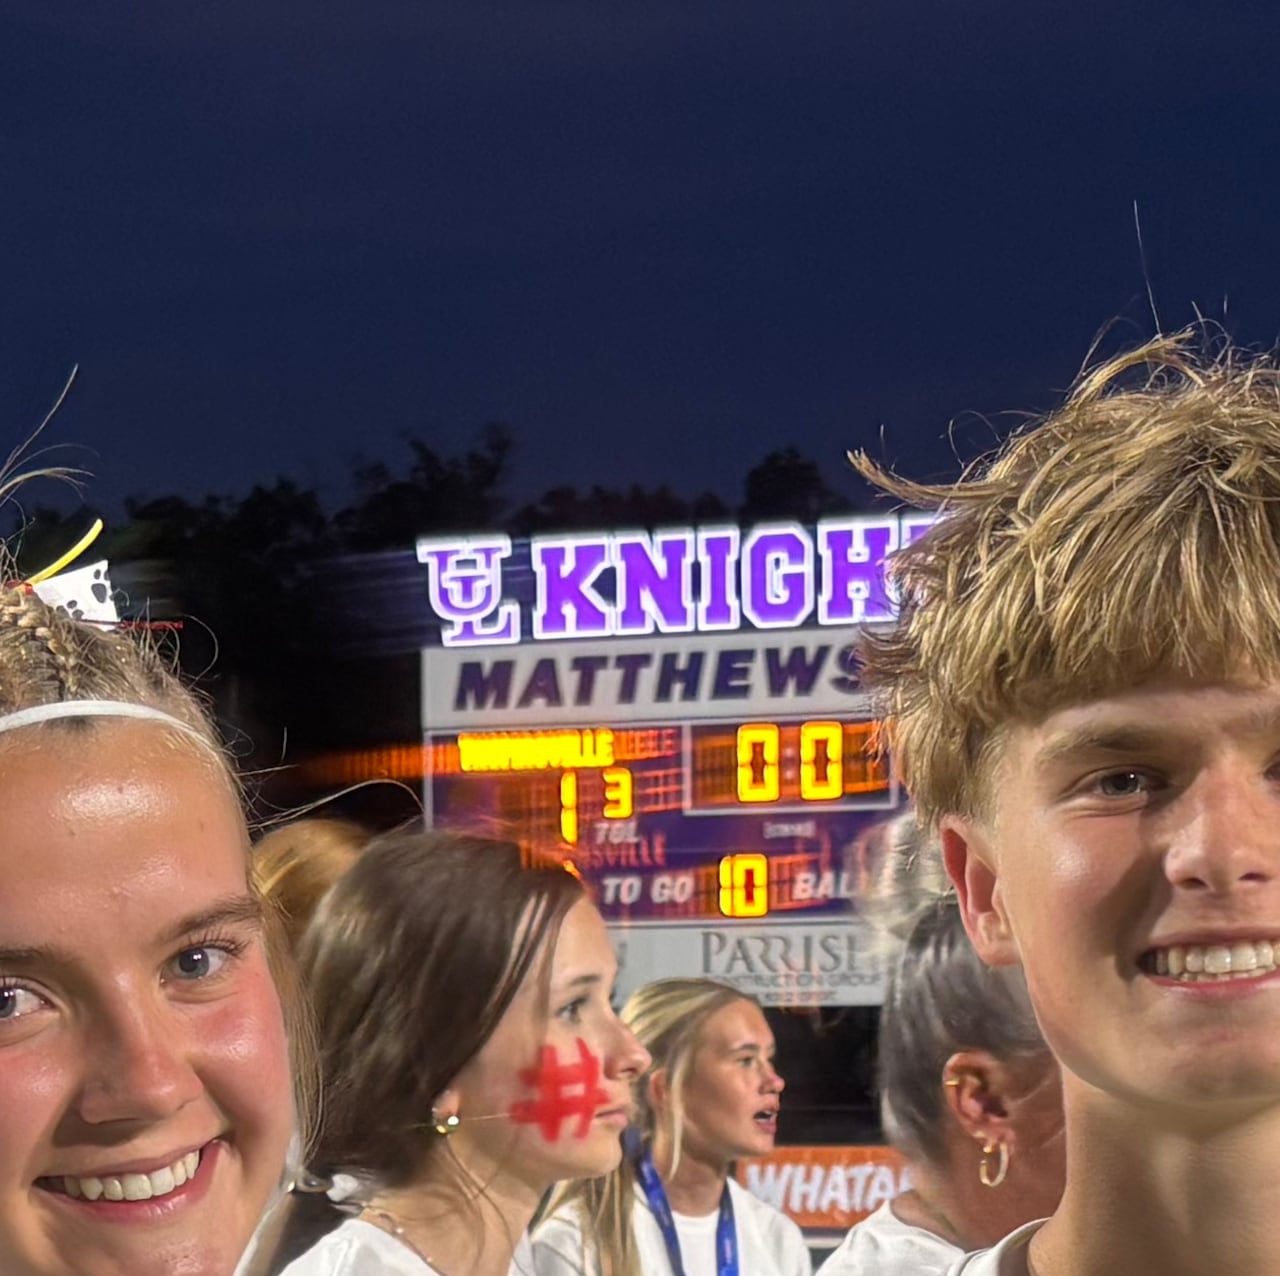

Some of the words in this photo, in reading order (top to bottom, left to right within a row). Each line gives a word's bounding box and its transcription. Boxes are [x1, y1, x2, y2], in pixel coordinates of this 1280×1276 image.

[531, 518, 950, 638] KNIGH
[602, 877, 642, 905] TO
[650, 876, 696, 904] GO
[792, 871, 858, 900] BAL
